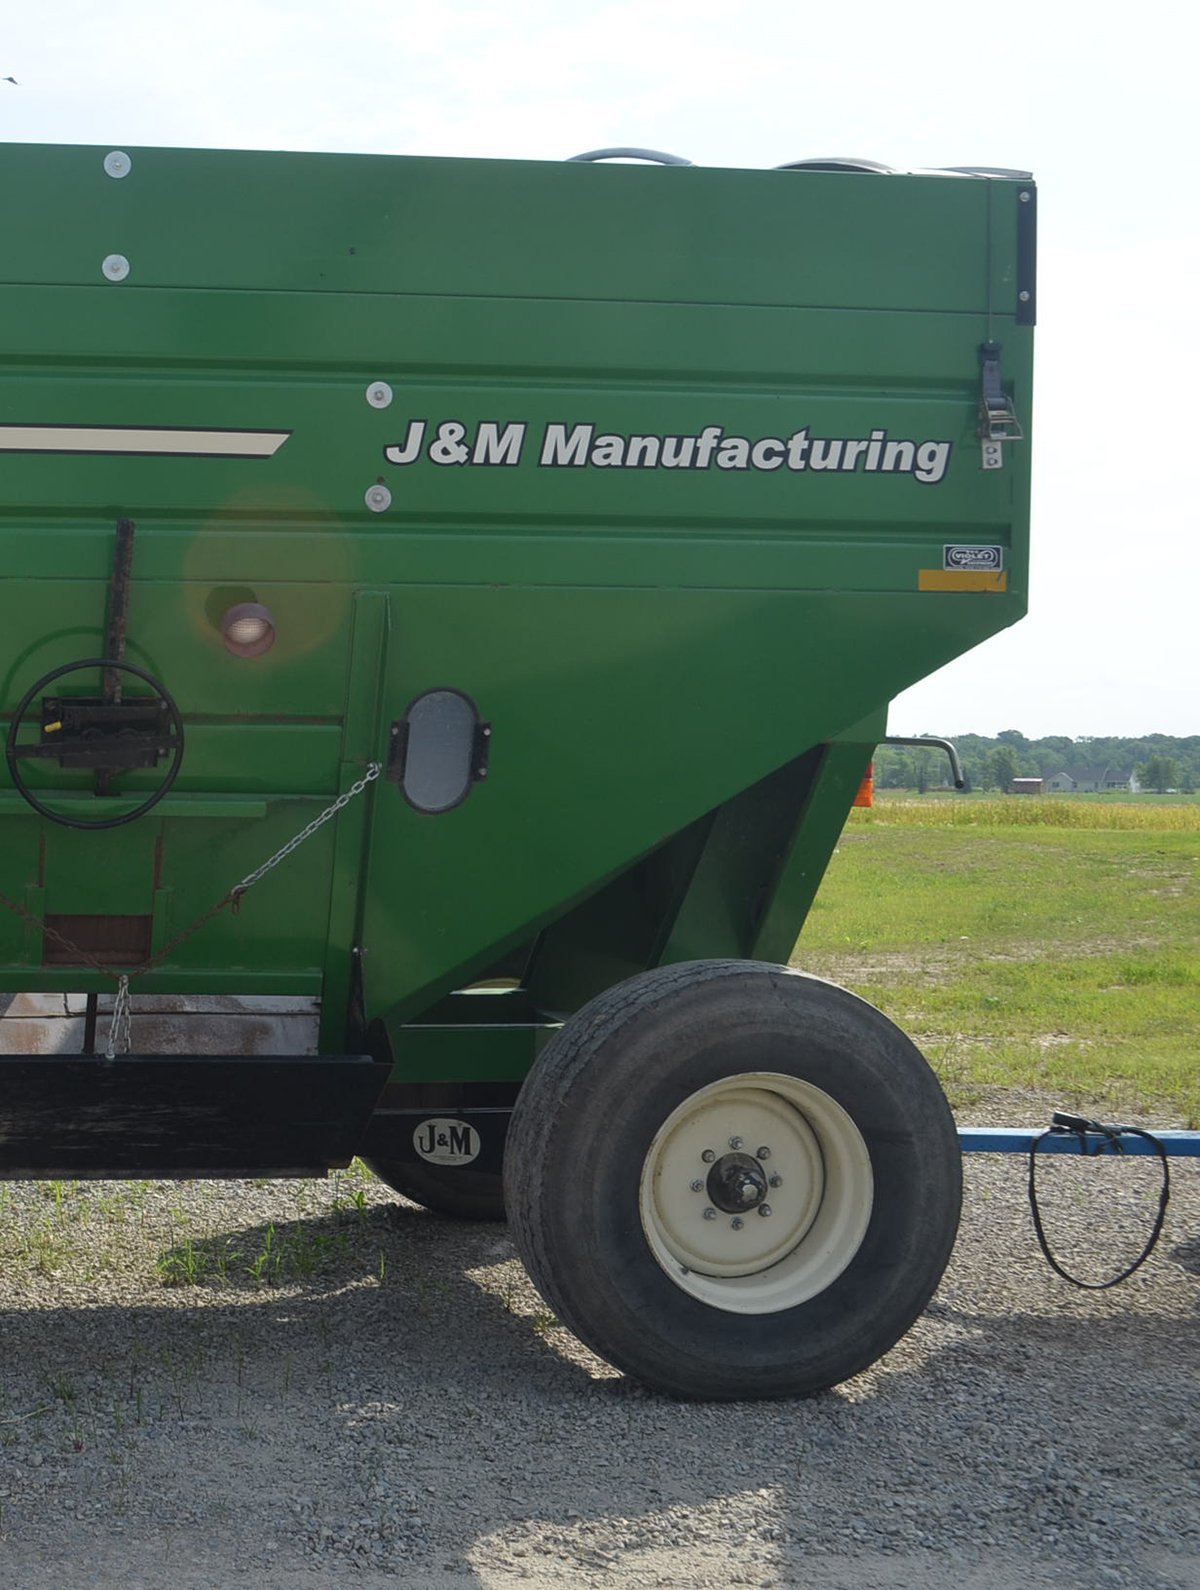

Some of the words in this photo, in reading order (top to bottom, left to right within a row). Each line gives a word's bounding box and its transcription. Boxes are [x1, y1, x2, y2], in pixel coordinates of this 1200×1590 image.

[384, 419, 528, 467] J&M
[538, 421, 952, 484] Manufacturing
[418, 1124, 472, 1156] J&M
